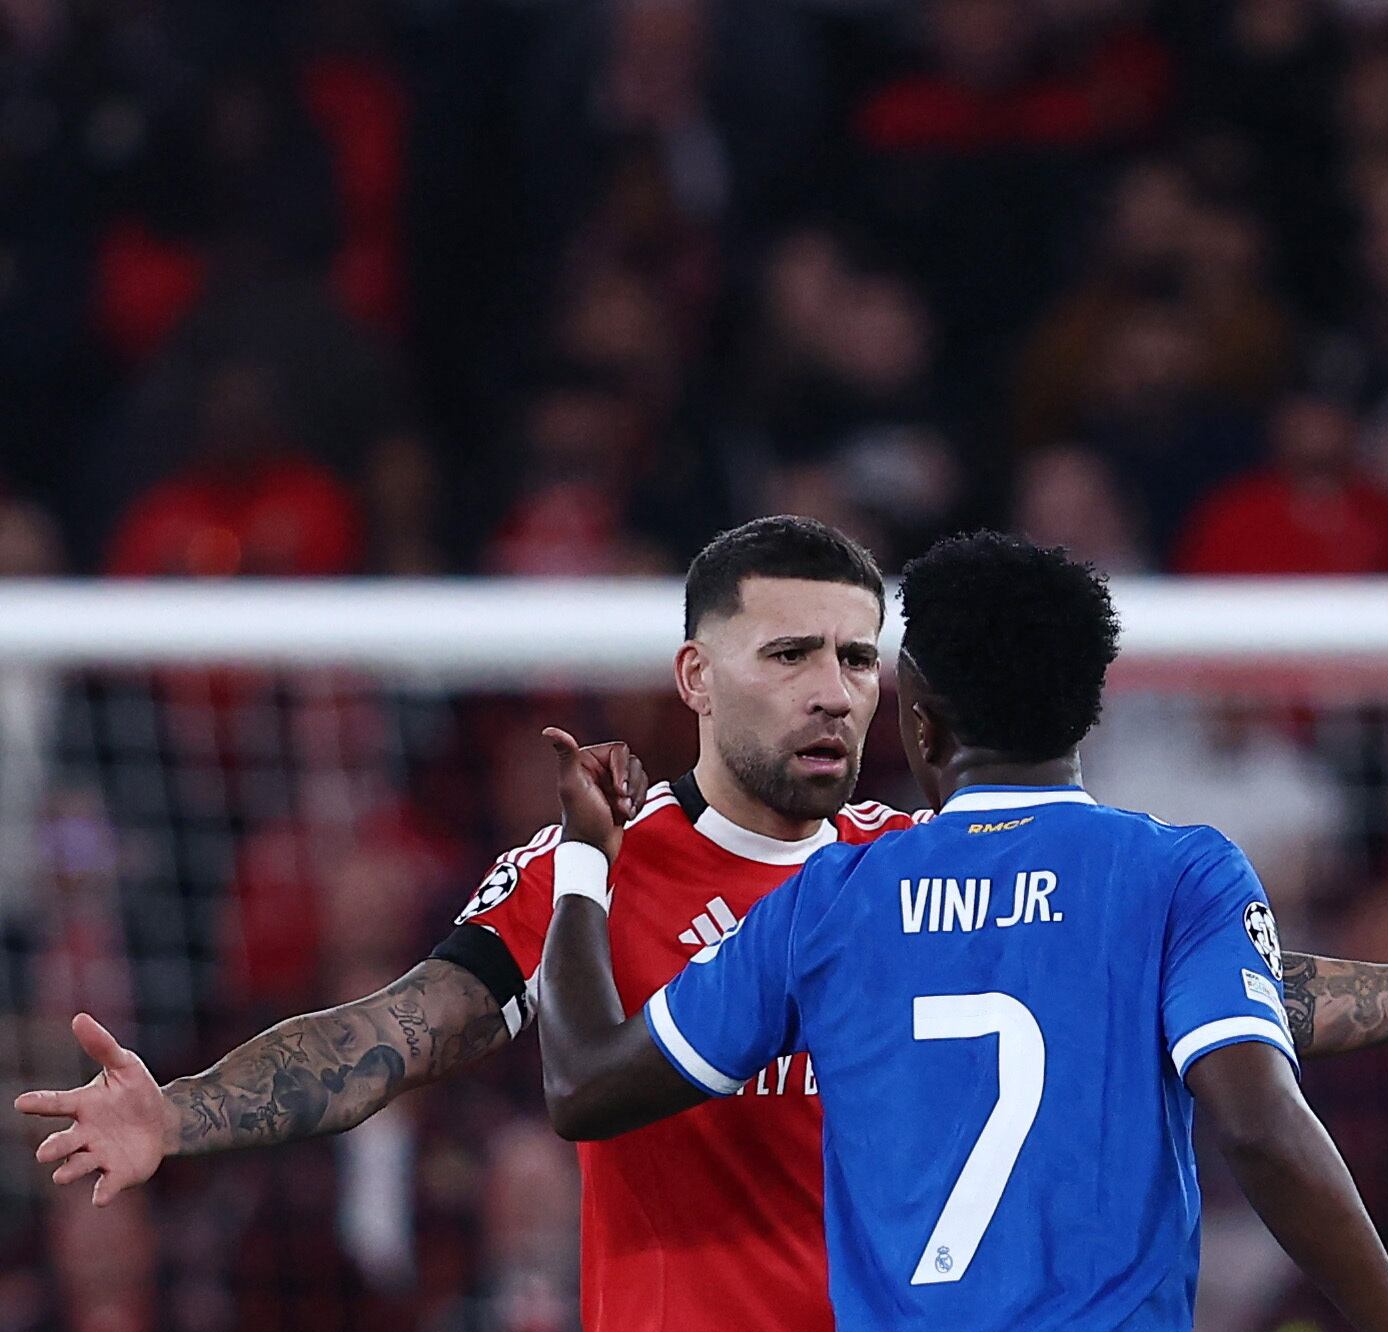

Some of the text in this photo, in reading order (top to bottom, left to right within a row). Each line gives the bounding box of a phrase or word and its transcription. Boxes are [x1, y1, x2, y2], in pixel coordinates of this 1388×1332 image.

[899, 870, 1064, 934] VINI JR.
[910, 992, 1046, 1285] 7
